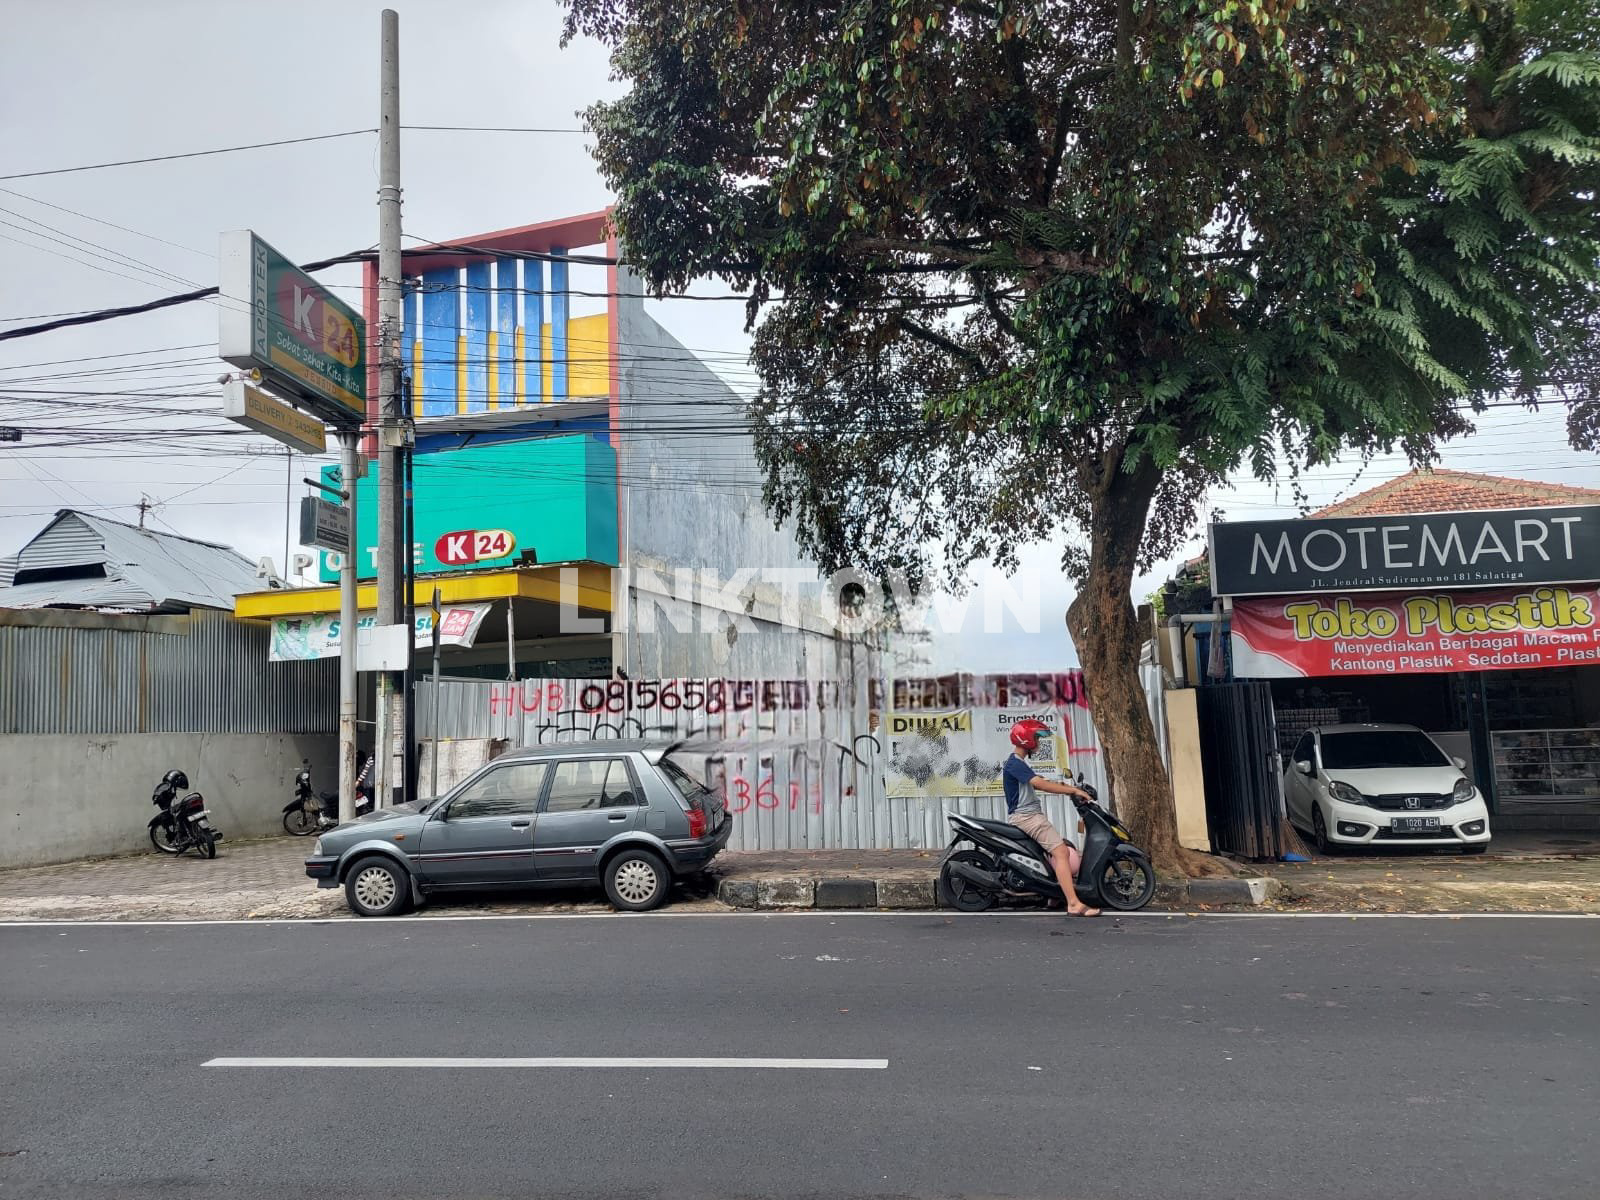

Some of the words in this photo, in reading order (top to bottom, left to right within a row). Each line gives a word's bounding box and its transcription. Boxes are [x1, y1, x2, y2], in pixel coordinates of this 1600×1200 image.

[255, 244, 268, 358] APOTEK
[276, 331, 301, 356] Sobat
[302, 348, 325, 372] Sehat
[1250, 516, 1582, 575] MOTEMART
[1378, 574, 1433, 584] Sudirman
[1453, 572, 1471, 580] 181
[1475, 571, 1524, 581] Salatiga
[450, 612, 470, 625] 24
[1287, 600, 1397, 639] Toko
[1405, 588, 1593, 634] Plastik
[1334, 639, 1435, 656] Menyediakan
[1439, 634, 1518, 651] Berbagai
[1523, 632, 1588, 647] Macam
[1331, 657, 1396, 672] Kantong
[1400, 654, 1454, 669] Plastik
[1467, 651, 1541, 667] Sedotan
